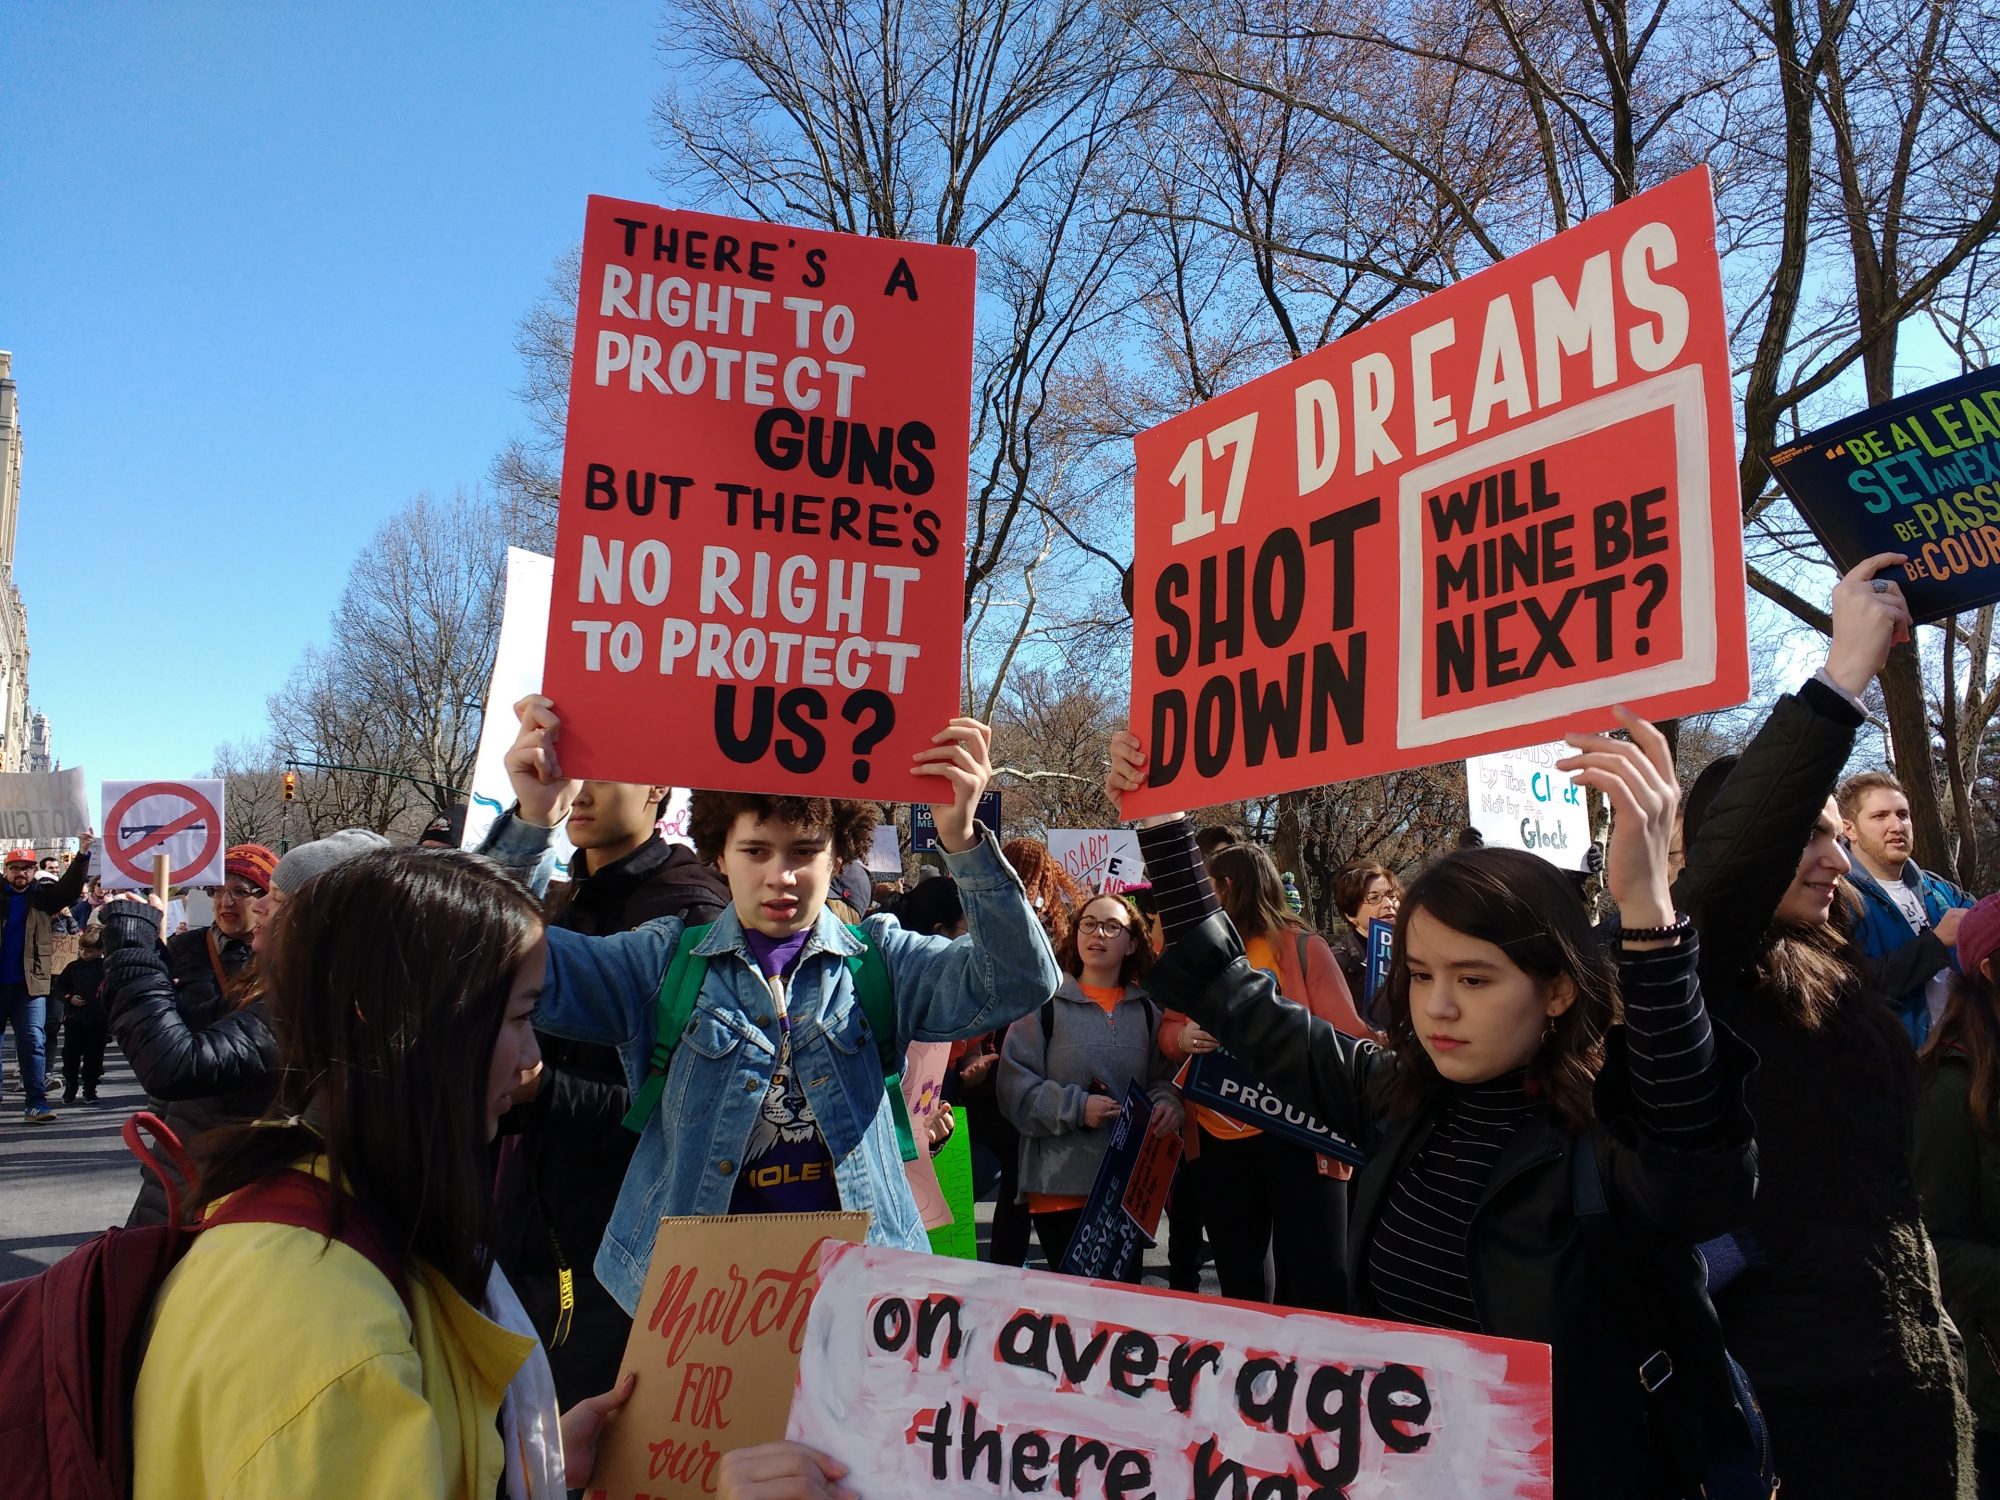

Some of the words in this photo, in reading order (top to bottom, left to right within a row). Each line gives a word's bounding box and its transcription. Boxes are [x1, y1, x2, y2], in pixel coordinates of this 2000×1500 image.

[614, 217, 827, 288] THERE'S
[884, 257, 918, 301] A
[600, 264, 771, 337] RIGHT
[783, 296, 855, 355] TO
[595, 330, 866, 417] PROTECT
[1168, 412, 1259, 546] 17
[1295, 222, 1690, 496] DREAMS
[754, 408, 936, 496] GUNS
[1848, 448, 1938, 513] SET
[1933, 463, 1966, 491] AN
[1953, 442, 2000, 486] EX
[1890, 422, 1916, 451] A
[585, 463, 695, 520] BUT
[714, 483, 941, 557] THERE'S
[1428, 459, 1561, 543] WILL
[1893, 518, 1923, 542] BE
[578, 535, 671, 607] NO
[700, 545, 920, 636] RIGHT
[1154, 497, 1381, 678] SHOT
[1435, 514, 1575, 610] MINE
[1593, 487, 1669, 571] BE
[1903, 558, 1929, 582] BE
[571, 620, 643, 673] TO
[659, 617, 920, 695] PROTECT
[1436, 563, 1669, 697] NEXT?
[714, 684, 896, 784] US?
[1148, 632, 1367, 788] DOWN
[1479, 758, 1498, 790] by
[1501, 764, 1526, 794] the
[1482, 793, 1504, 813] Not
[1520, 817, 1568, 850] Glock
[1219, 1078, 1357, 1148] PROUD
[1072, 1224, 1091, 1263] DO
[1078, 1176, 1120, 1274] JUSTICE
[1084, 1213, 1115, 1277] LOVE
[1092, 1209, 1123, 1278] MERC
[648, 1236, 832, 1368] March
[671, 1362, 733, 1429] FOR
[873, 1295, 963, 1360] on
[999, 1313, 1432, 1488] average
[648, 1438, 721, 1494] our
[916, 1400, 1157, 1500] there
